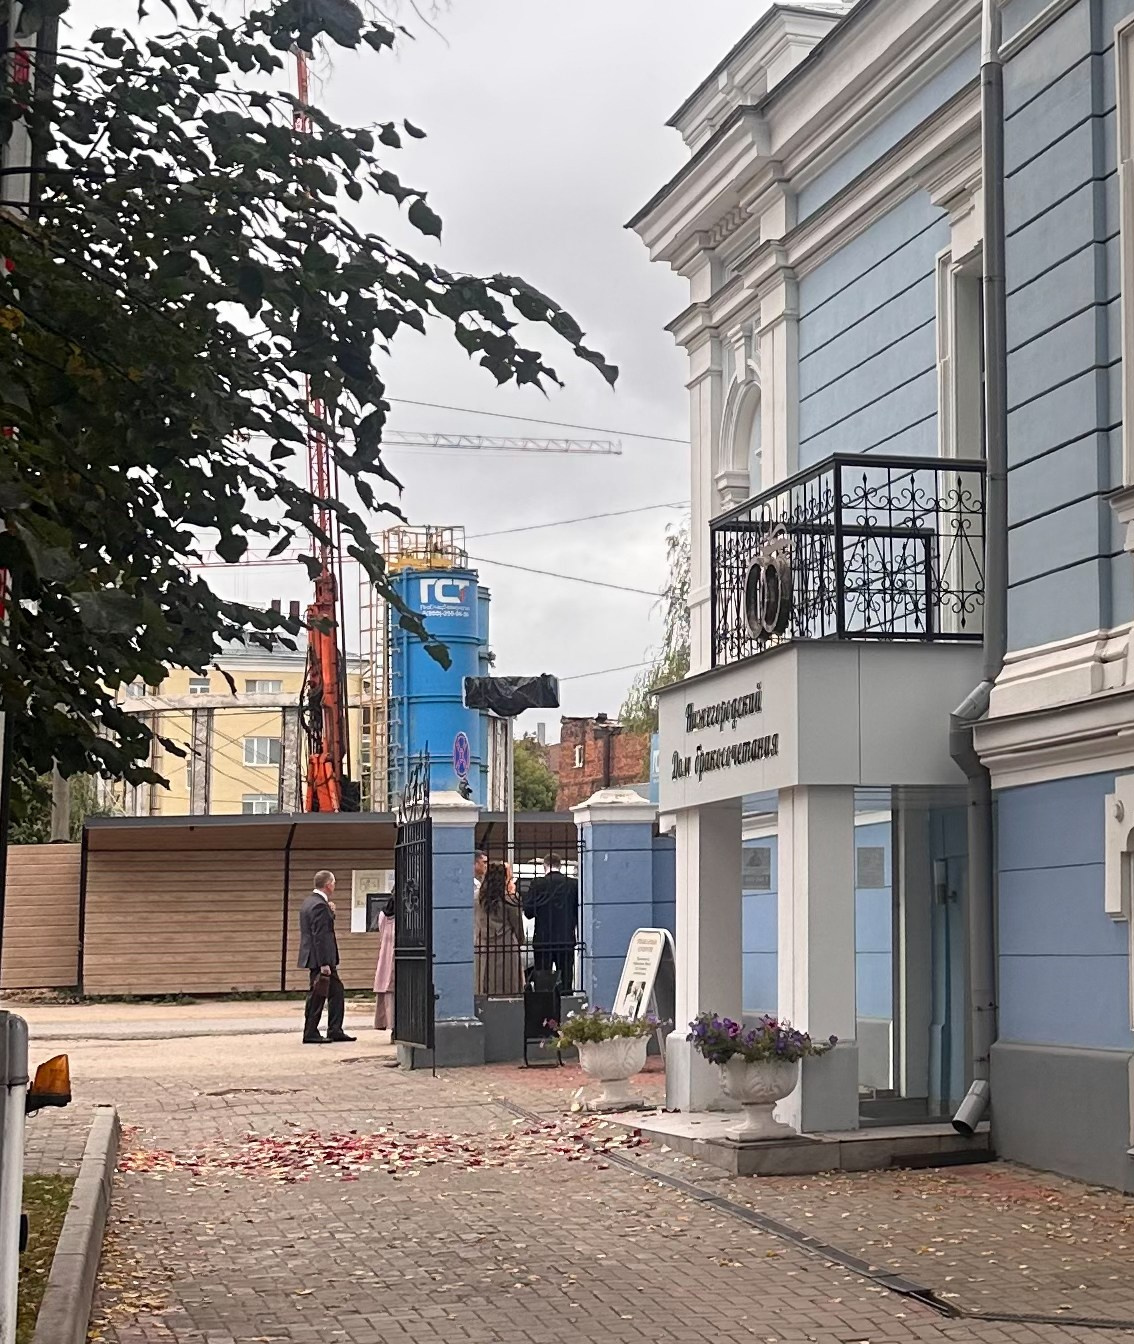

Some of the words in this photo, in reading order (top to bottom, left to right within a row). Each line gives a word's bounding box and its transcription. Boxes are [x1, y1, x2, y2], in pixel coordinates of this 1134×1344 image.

[685, 681, 762, 733] Нижегородский
[671, 750, 692, 780] Дом
[694, 733, 779, 782] бракосочетания
